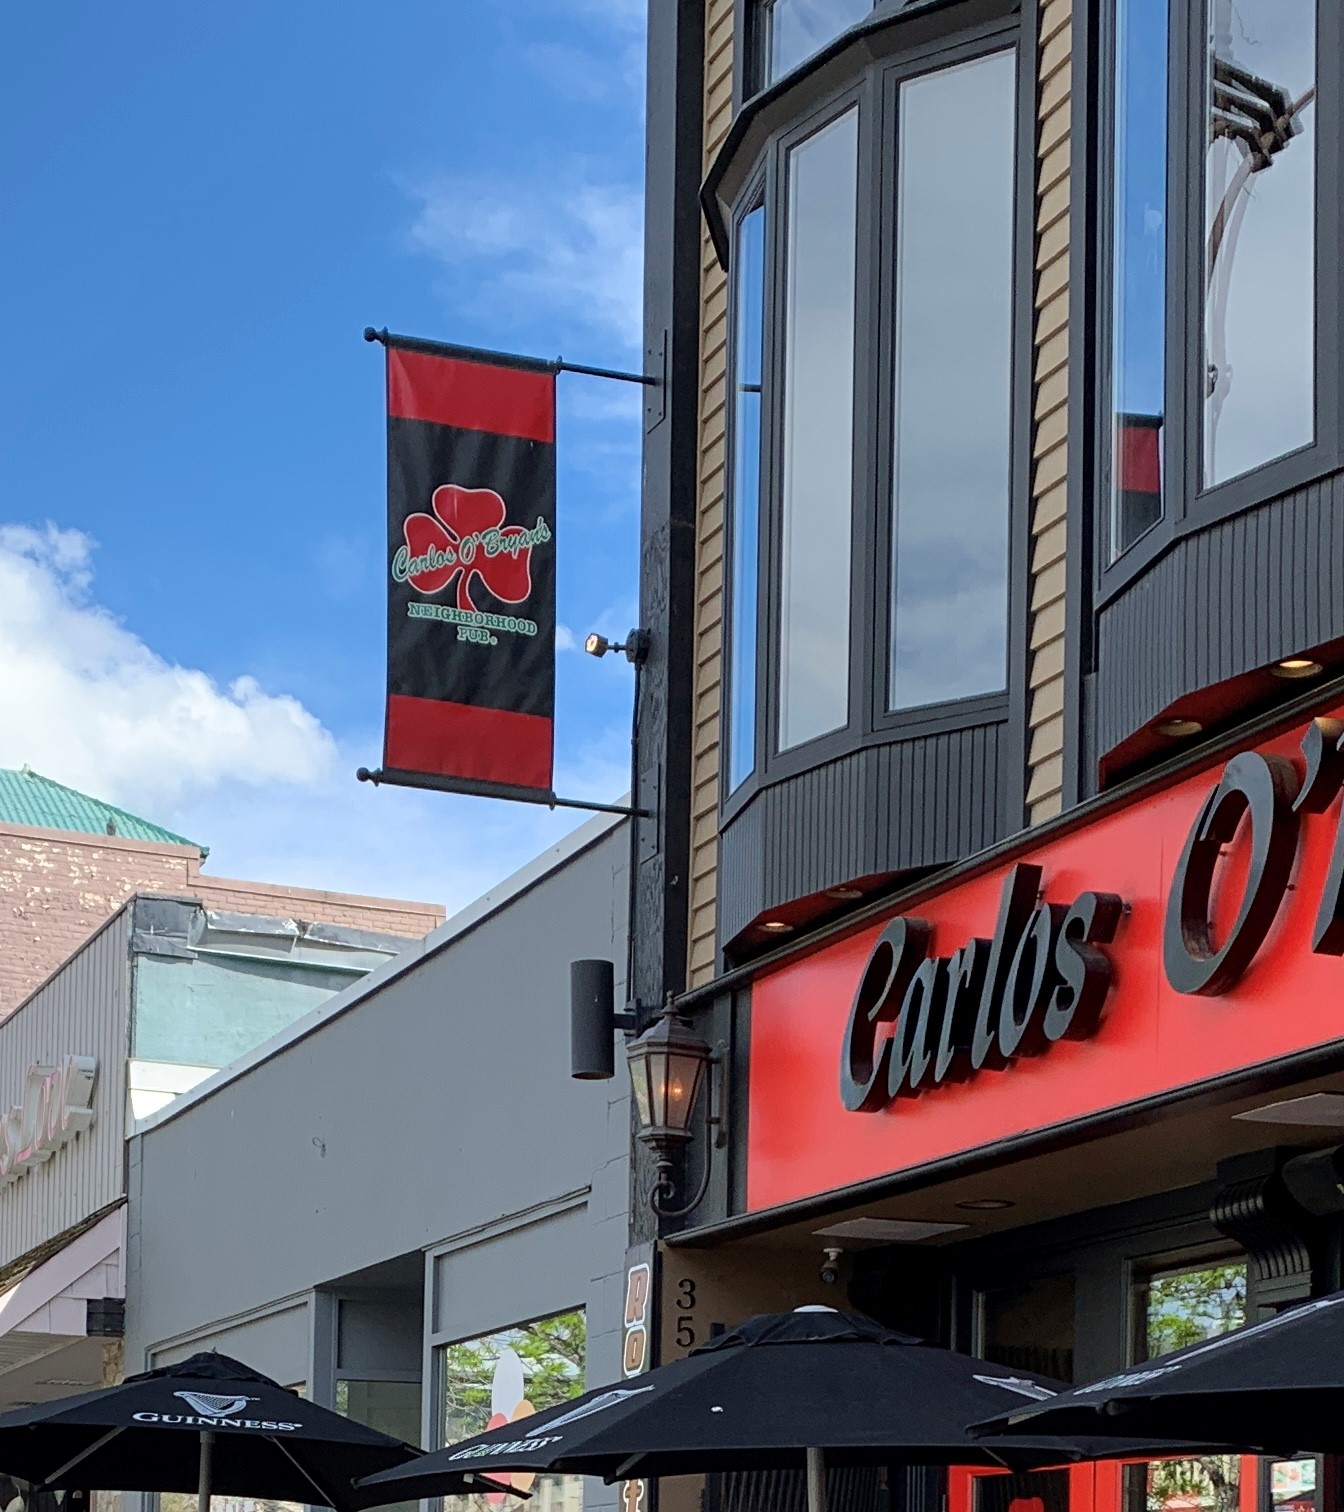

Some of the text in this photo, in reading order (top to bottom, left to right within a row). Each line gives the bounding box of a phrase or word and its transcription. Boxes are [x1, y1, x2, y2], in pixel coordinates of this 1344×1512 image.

[391, 516, 551, 582] Carlos O'Bryan's
[407, 601, 537, 636] NEIGHBORHOOD
[457, 626, 491, 645] PUB
[839, 864, 1131, 1113] Carlos
[132, 1411, 302, 1431] GUINNESS
[448, 1436, 560, 1461] GUINNESS
